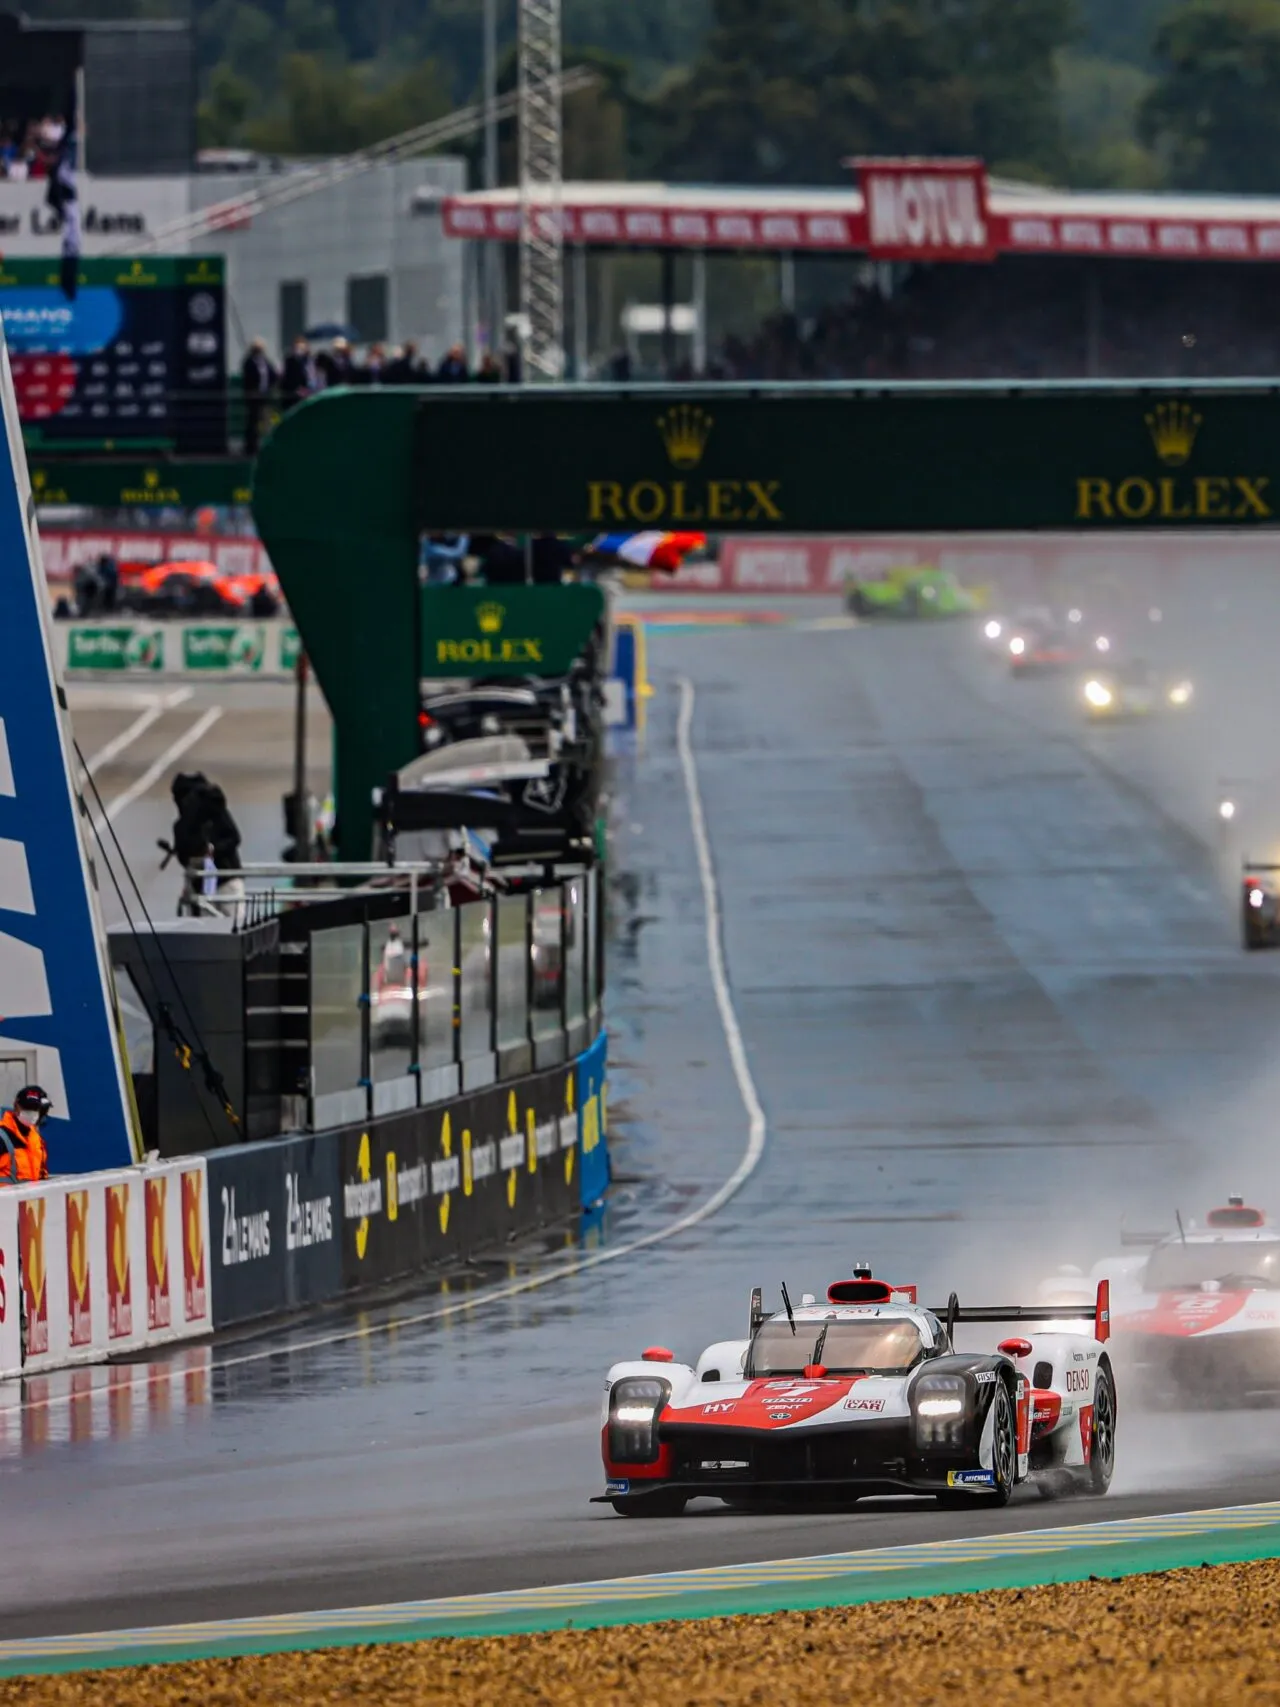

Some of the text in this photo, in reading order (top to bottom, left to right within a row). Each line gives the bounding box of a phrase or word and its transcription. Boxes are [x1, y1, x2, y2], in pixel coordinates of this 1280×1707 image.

[869, 175, 987, 247] MOTUL
[588, 481, 782, 521] ROLEX
[1077, 477, 1270, 518] ROLEX
[437, 640, 543, 663] ROLEX
[772, 1386, 821, 1397] 7
[1066, 1368, 1089, 1392] DENSO
[703, 1402, 734, 1414] HY
[847, 1402, 881, 1412] CAR
